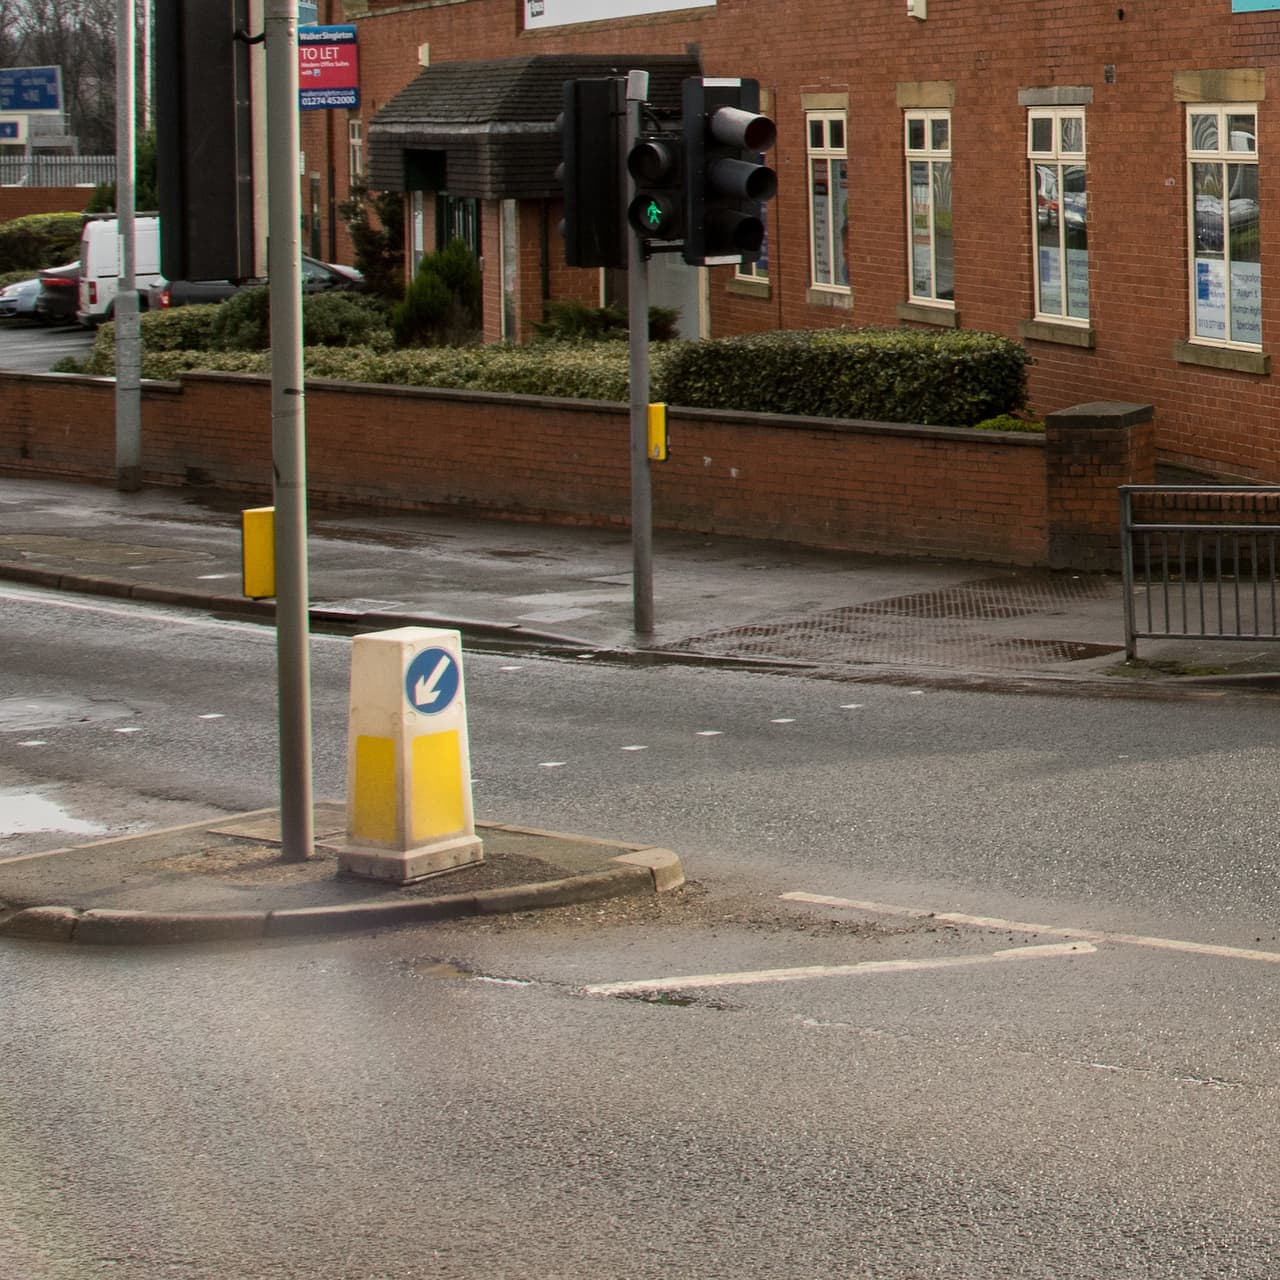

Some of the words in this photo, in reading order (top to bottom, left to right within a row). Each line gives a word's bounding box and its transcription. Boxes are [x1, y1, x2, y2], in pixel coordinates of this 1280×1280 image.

[301, 48, 318, 60] TO
[320, 47, 339, 60] LET
[302, 97, 326, 106] 01274
[327, 96, 355, 105] 452000
